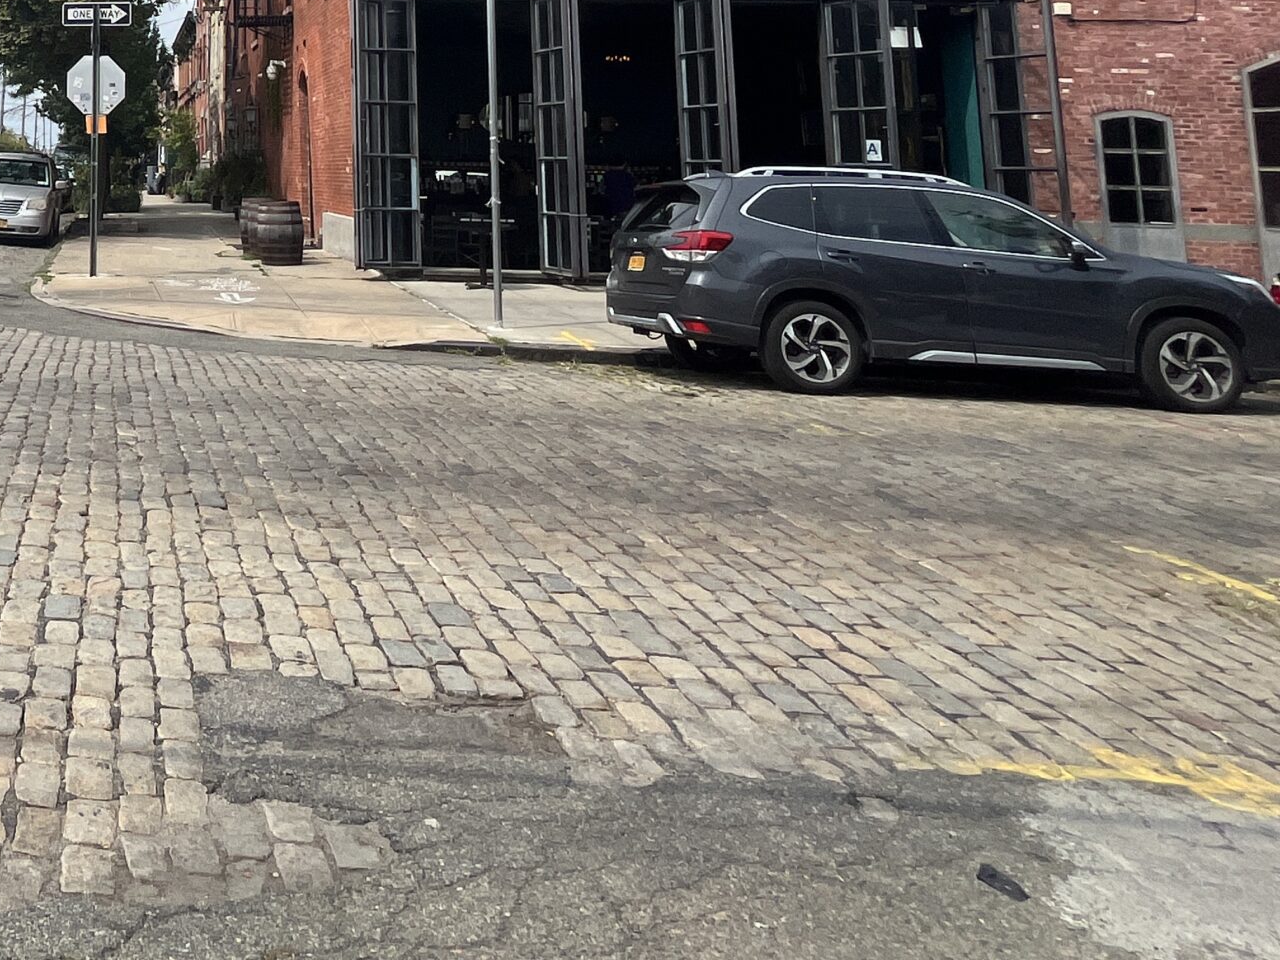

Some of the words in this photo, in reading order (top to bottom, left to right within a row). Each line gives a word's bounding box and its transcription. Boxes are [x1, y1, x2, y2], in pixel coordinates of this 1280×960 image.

[72, 10, 92, 19] ONE
[100, 9, 121, 19] WAY
[867, 142, 878, 155] A
